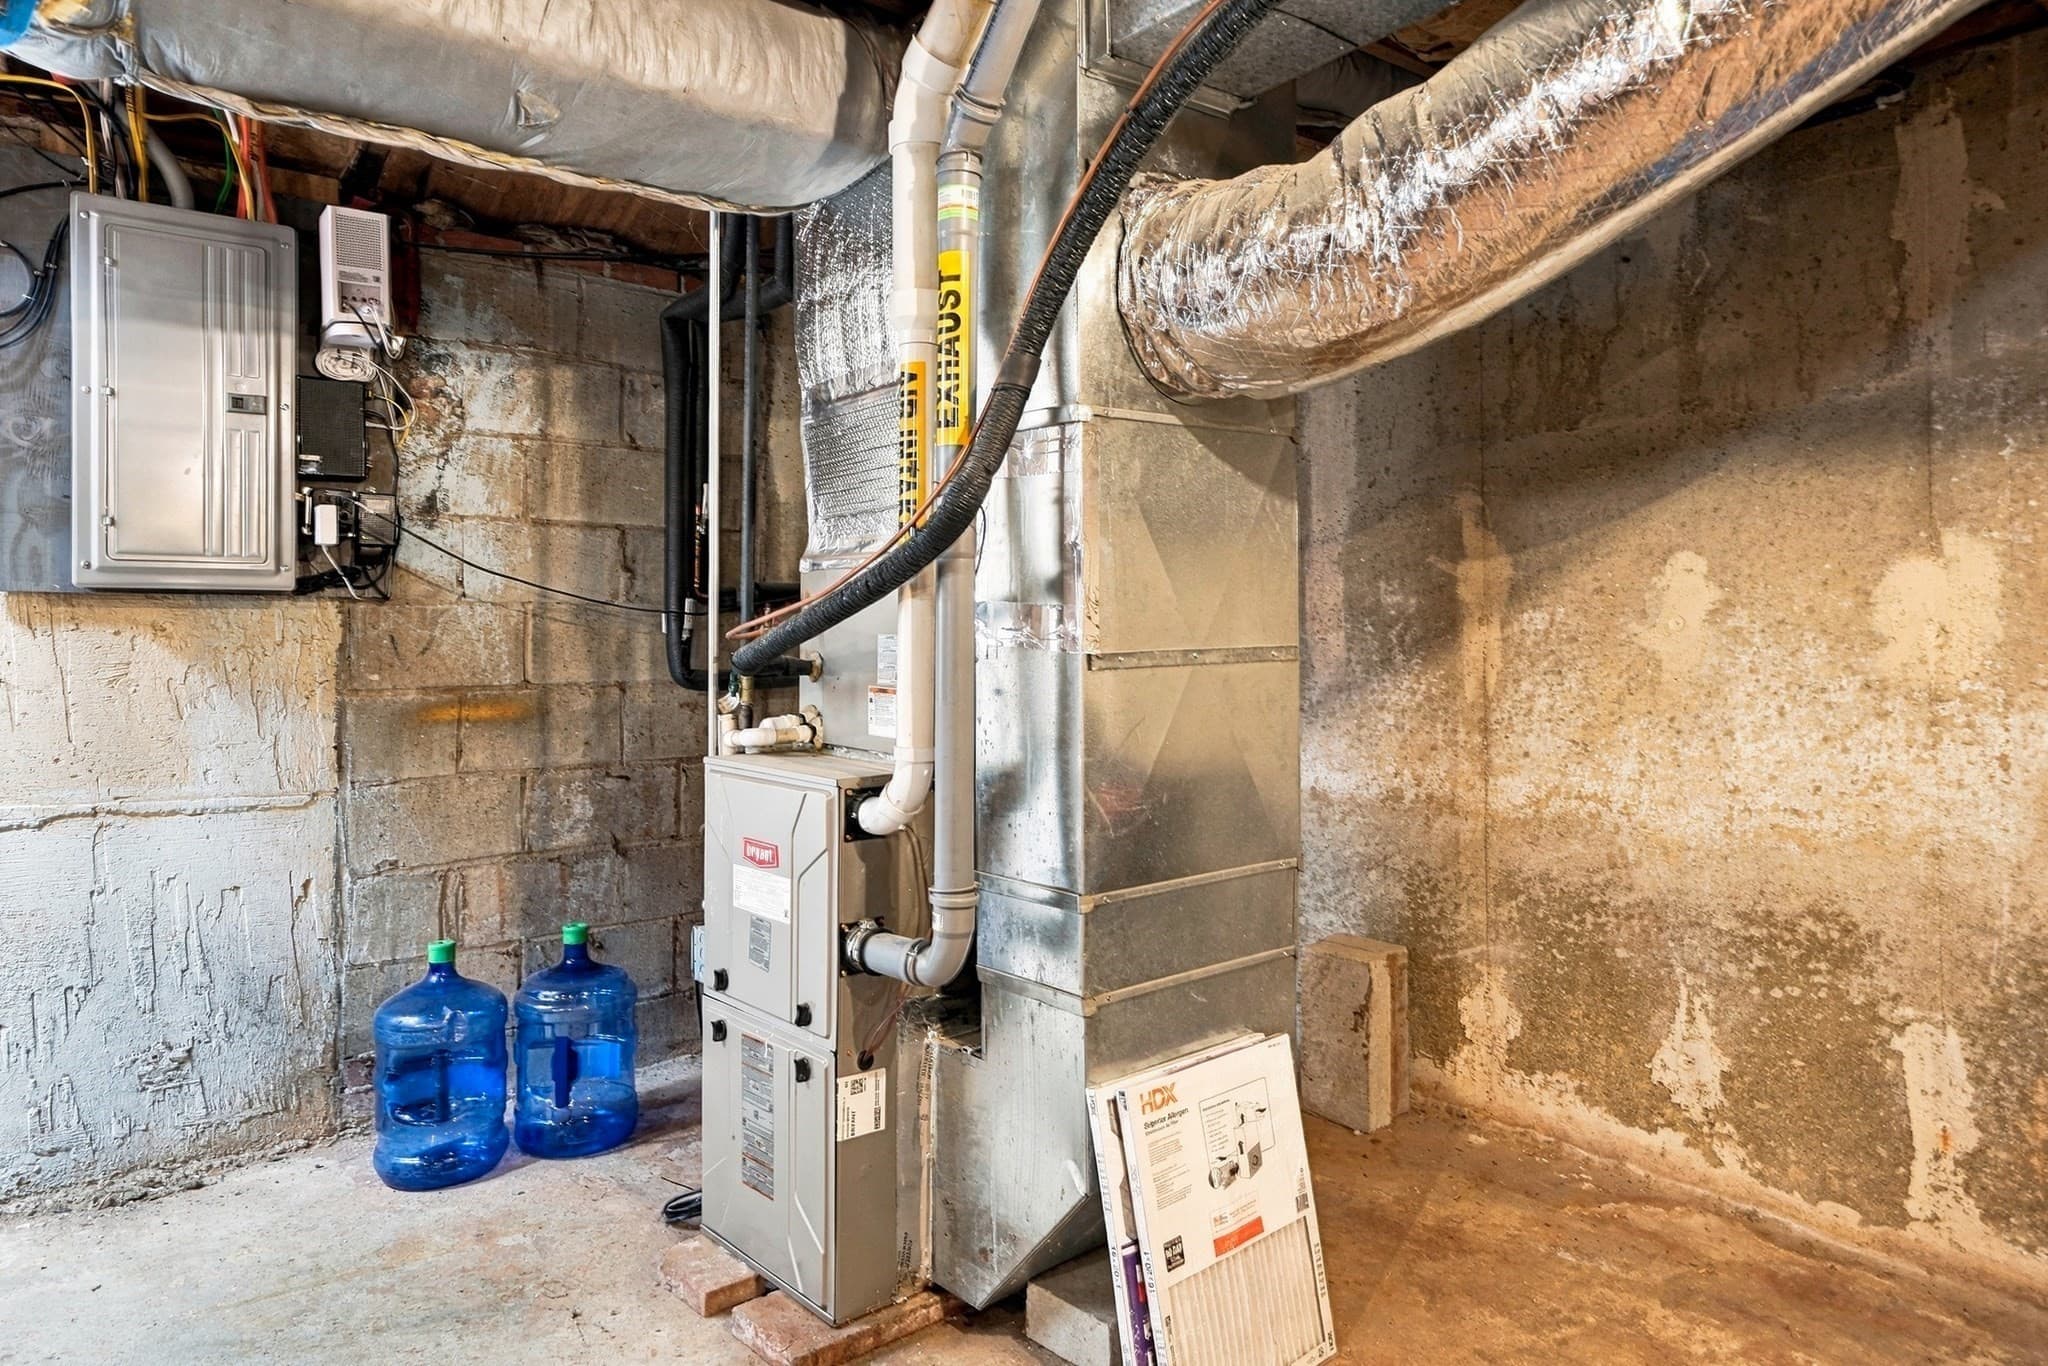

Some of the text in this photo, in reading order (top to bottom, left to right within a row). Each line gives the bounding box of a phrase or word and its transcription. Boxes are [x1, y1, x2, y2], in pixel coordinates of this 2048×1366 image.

[938, 269, 961, 429] EXHAUST
[898, 371, 918, 530] AIR INTAK
[1140, 1082, 1178, 1115] HDX
